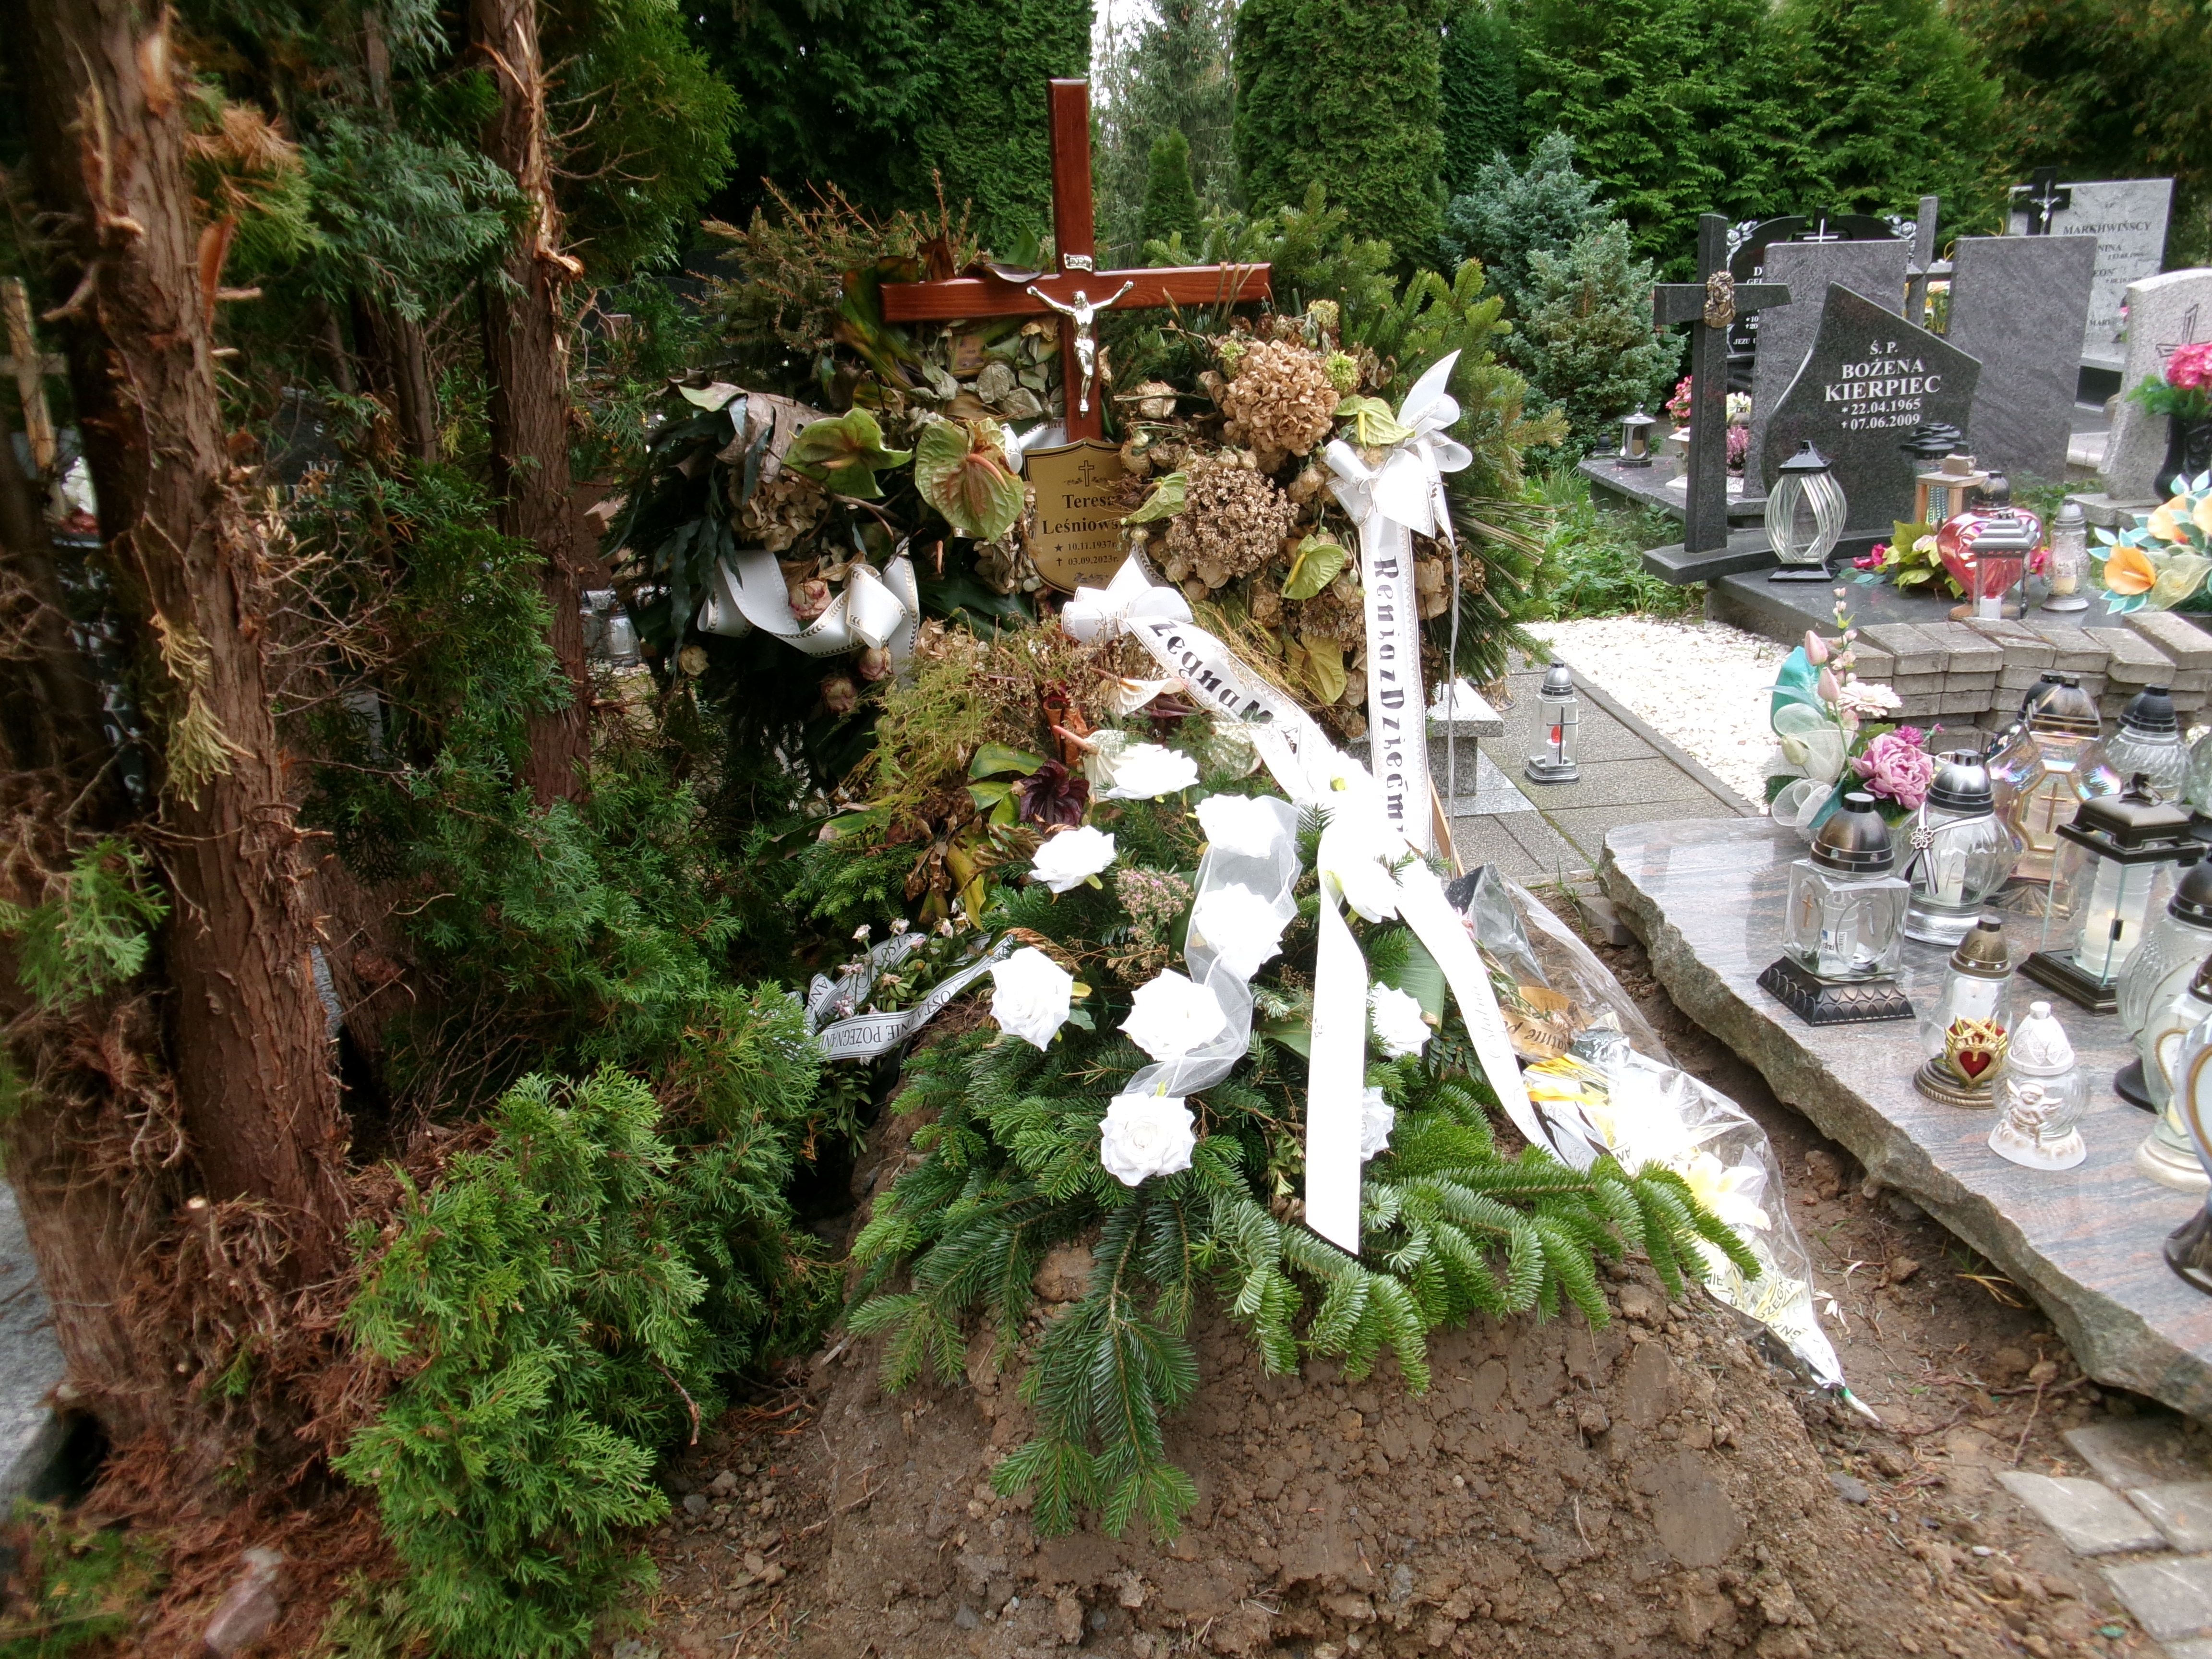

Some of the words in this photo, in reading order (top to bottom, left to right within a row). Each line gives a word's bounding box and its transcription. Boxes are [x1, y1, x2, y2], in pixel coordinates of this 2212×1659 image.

[2098, 244, 2122, 252] NINA
[1887, 342, 1898, 353] P.
[1841, 358, 1924, 379] BOŻENA
[1824, 375, 1941, 402] KIERPIEC
[1851, 398, 1921, 415] 22.04.1965
[1850, 413, 1920, 430] 07.06.2009
[1068, 556, 1119, 566] 03.09.2023r.
